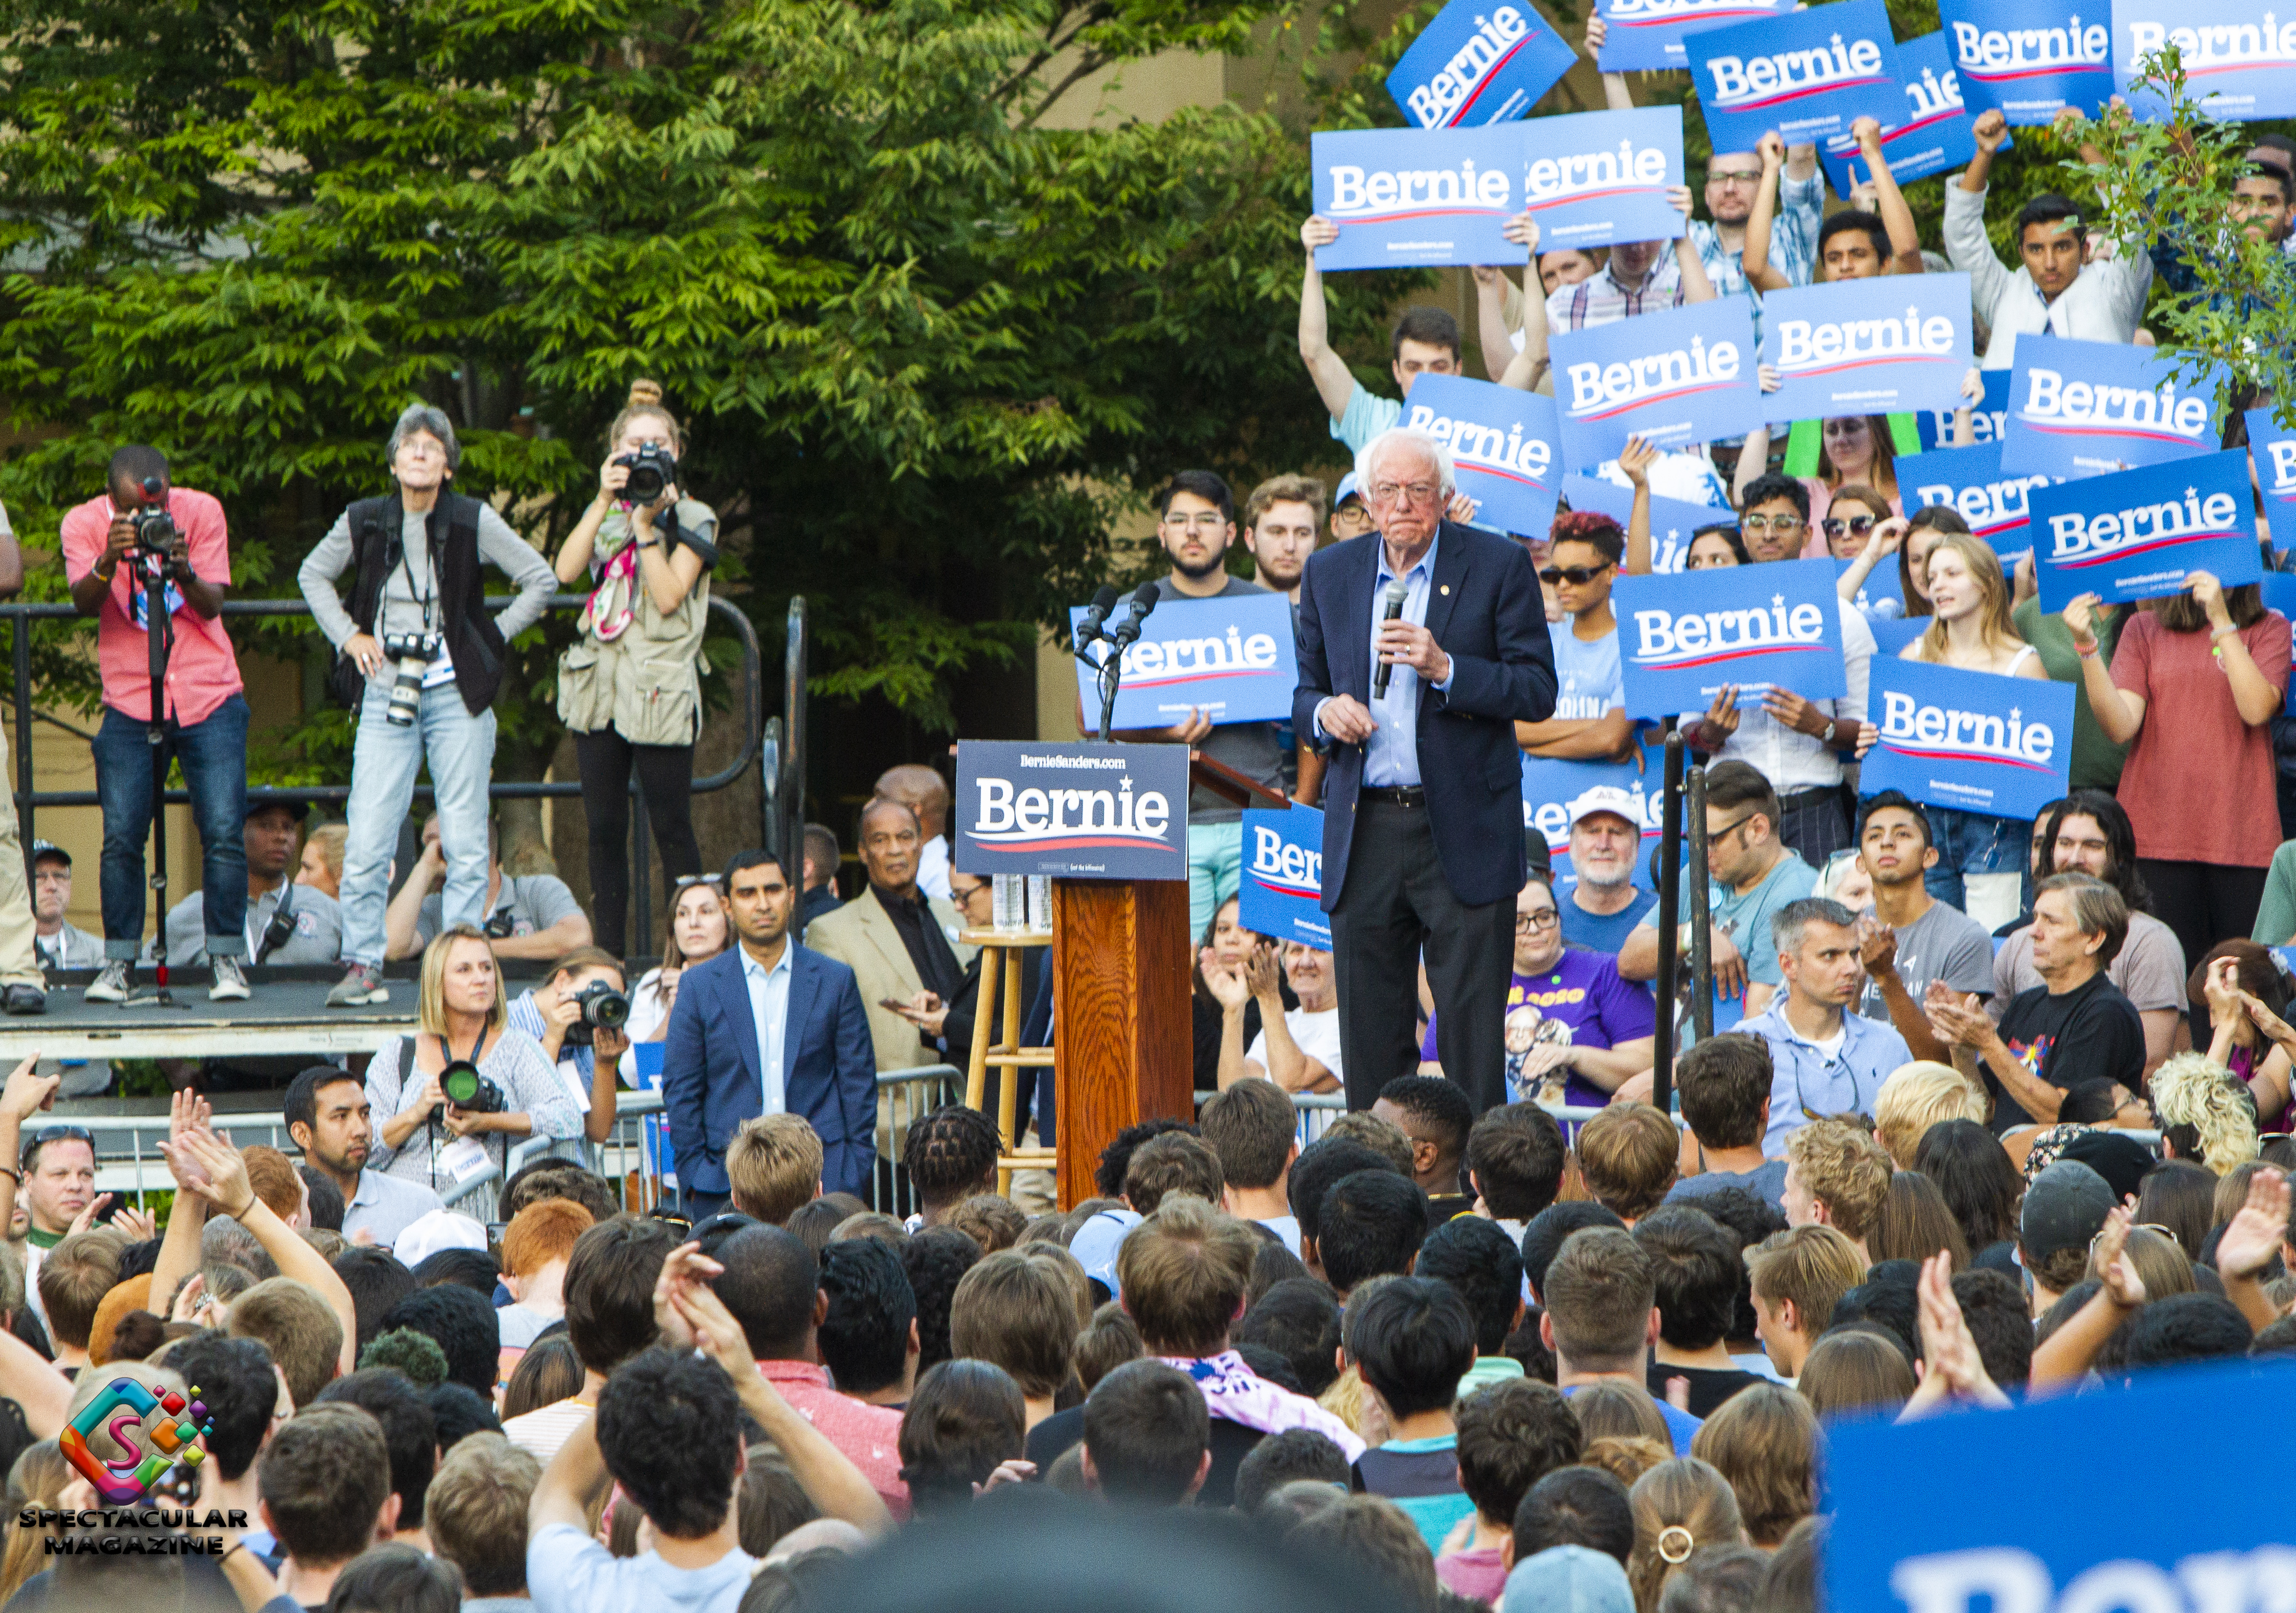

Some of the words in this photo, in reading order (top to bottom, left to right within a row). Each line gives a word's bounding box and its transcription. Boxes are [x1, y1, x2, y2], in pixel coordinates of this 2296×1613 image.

[1407, 6, 1527, 129] Bernie
[1706, 32, 1883, 100] Bernie
[1953, 15, 2108, 66] Bernie
[1329, 157, 1510, 209] Bernie
[1525, 139, 1666, 194] ernie
[1778, 304, 1955, 365] Bernie
[1567, 333, 1740, 410] Bernie
[2024, 369, 2208, 436] Bernie
[1408, 405, 1551, 477] Bernie
[2048, 485, 2237, 557] Bernie
[1634, 593, 1824, 656] Bernie
[1881, 691, 2055, 763] Bernie
[1020, 754, 1126, 769] BernieSanders.com
[975, 774, 1169, 835] Bernie
